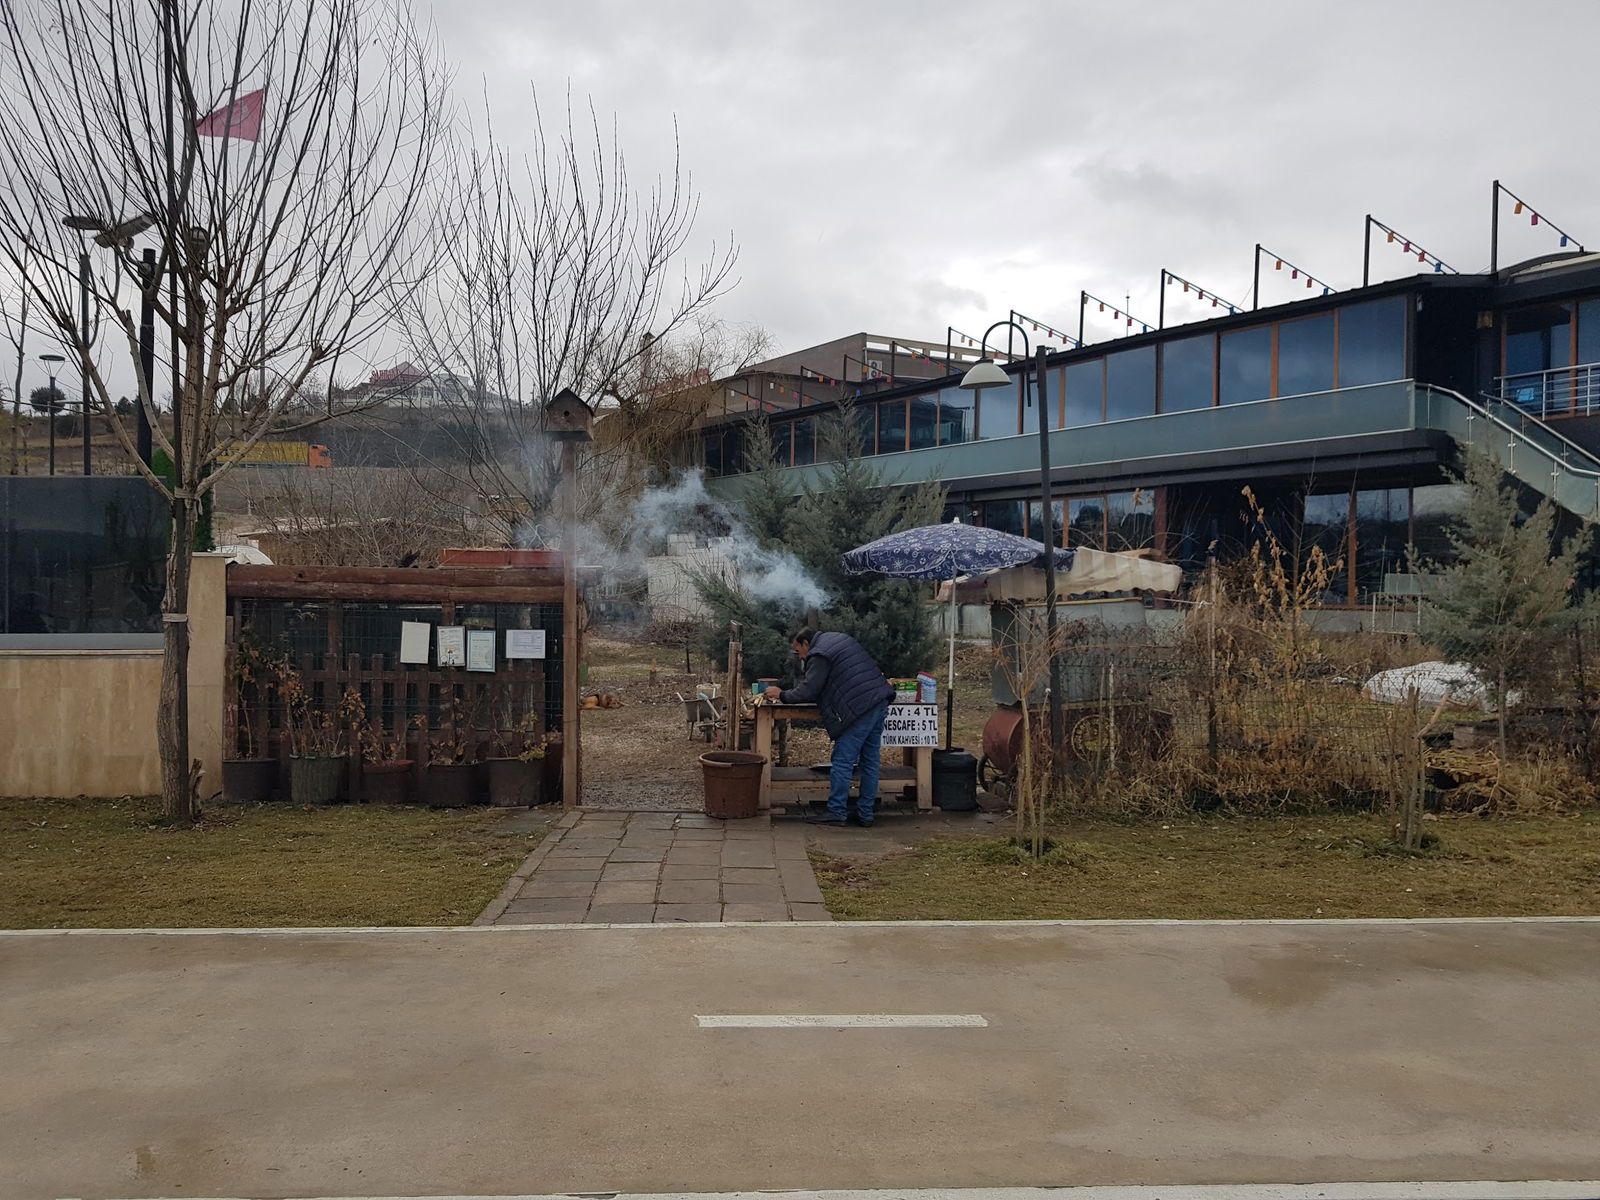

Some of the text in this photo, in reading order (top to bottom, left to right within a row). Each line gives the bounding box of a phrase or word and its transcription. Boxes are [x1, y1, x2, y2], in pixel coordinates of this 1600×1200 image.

[914, 707, 920, 716] 4
[923, 707, 937, 716] TL
[921, 720, 927, 731] 5
[928, 720, 938, 731] TL
[882, 733, 897, 745] TÜRK
[924, 735, 931, 745] 10
[931, 735, 938, 745] TL
